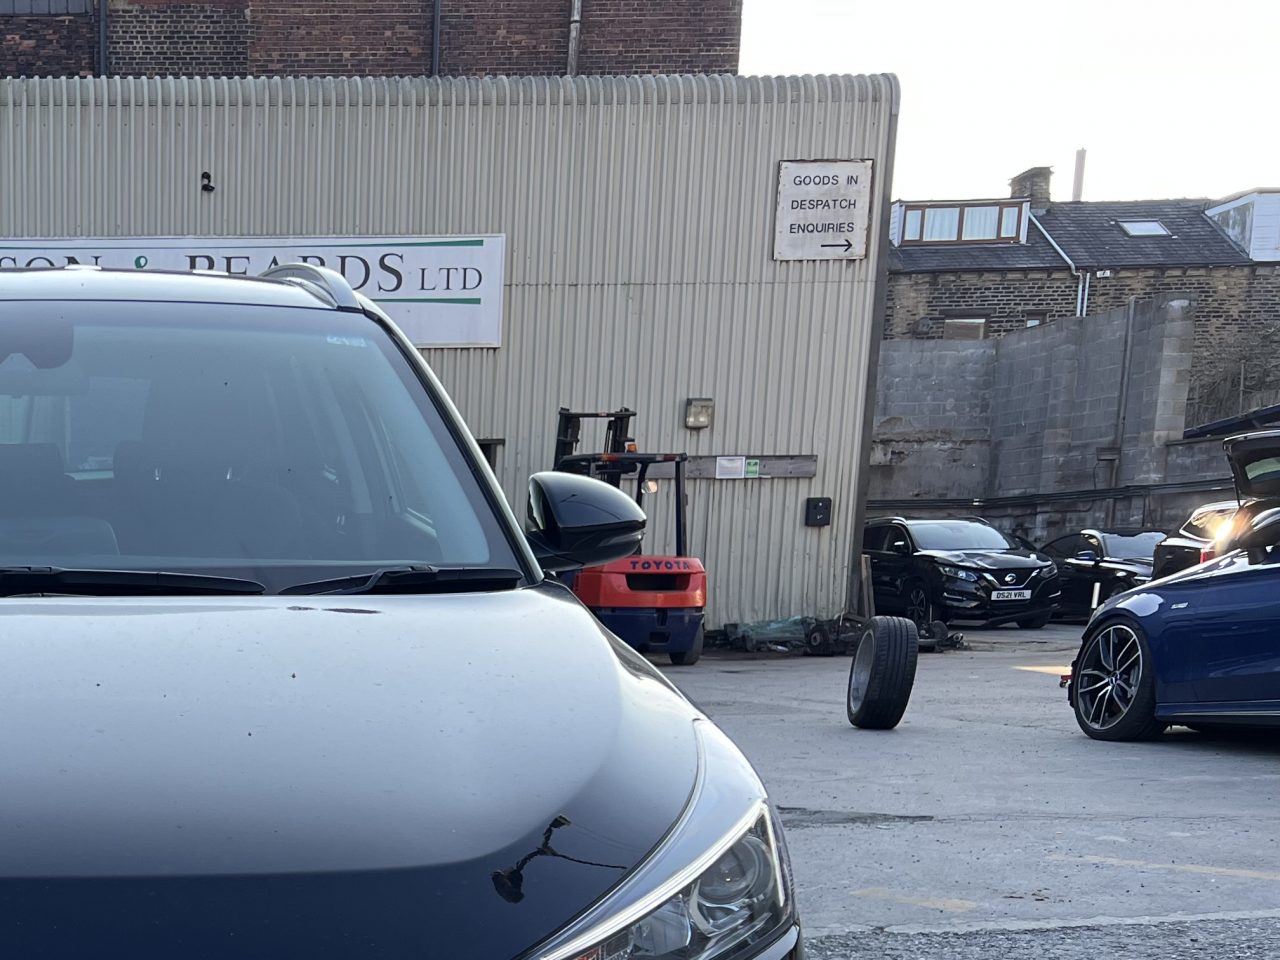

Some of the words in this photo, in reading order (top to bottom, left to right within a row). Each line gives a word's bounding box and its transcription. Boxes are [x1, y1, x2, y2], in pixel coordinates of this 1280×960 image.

[793, 175, 839, 186] GOODS
[846, 175, 858, 184] IN
[791, 199, 856, 210] DESPATCH
[789, 222, 854, 234] ENQUIRIES
[418, 267, 482, 291] LTD
[630, 560, 690, 570] TOYOTA
